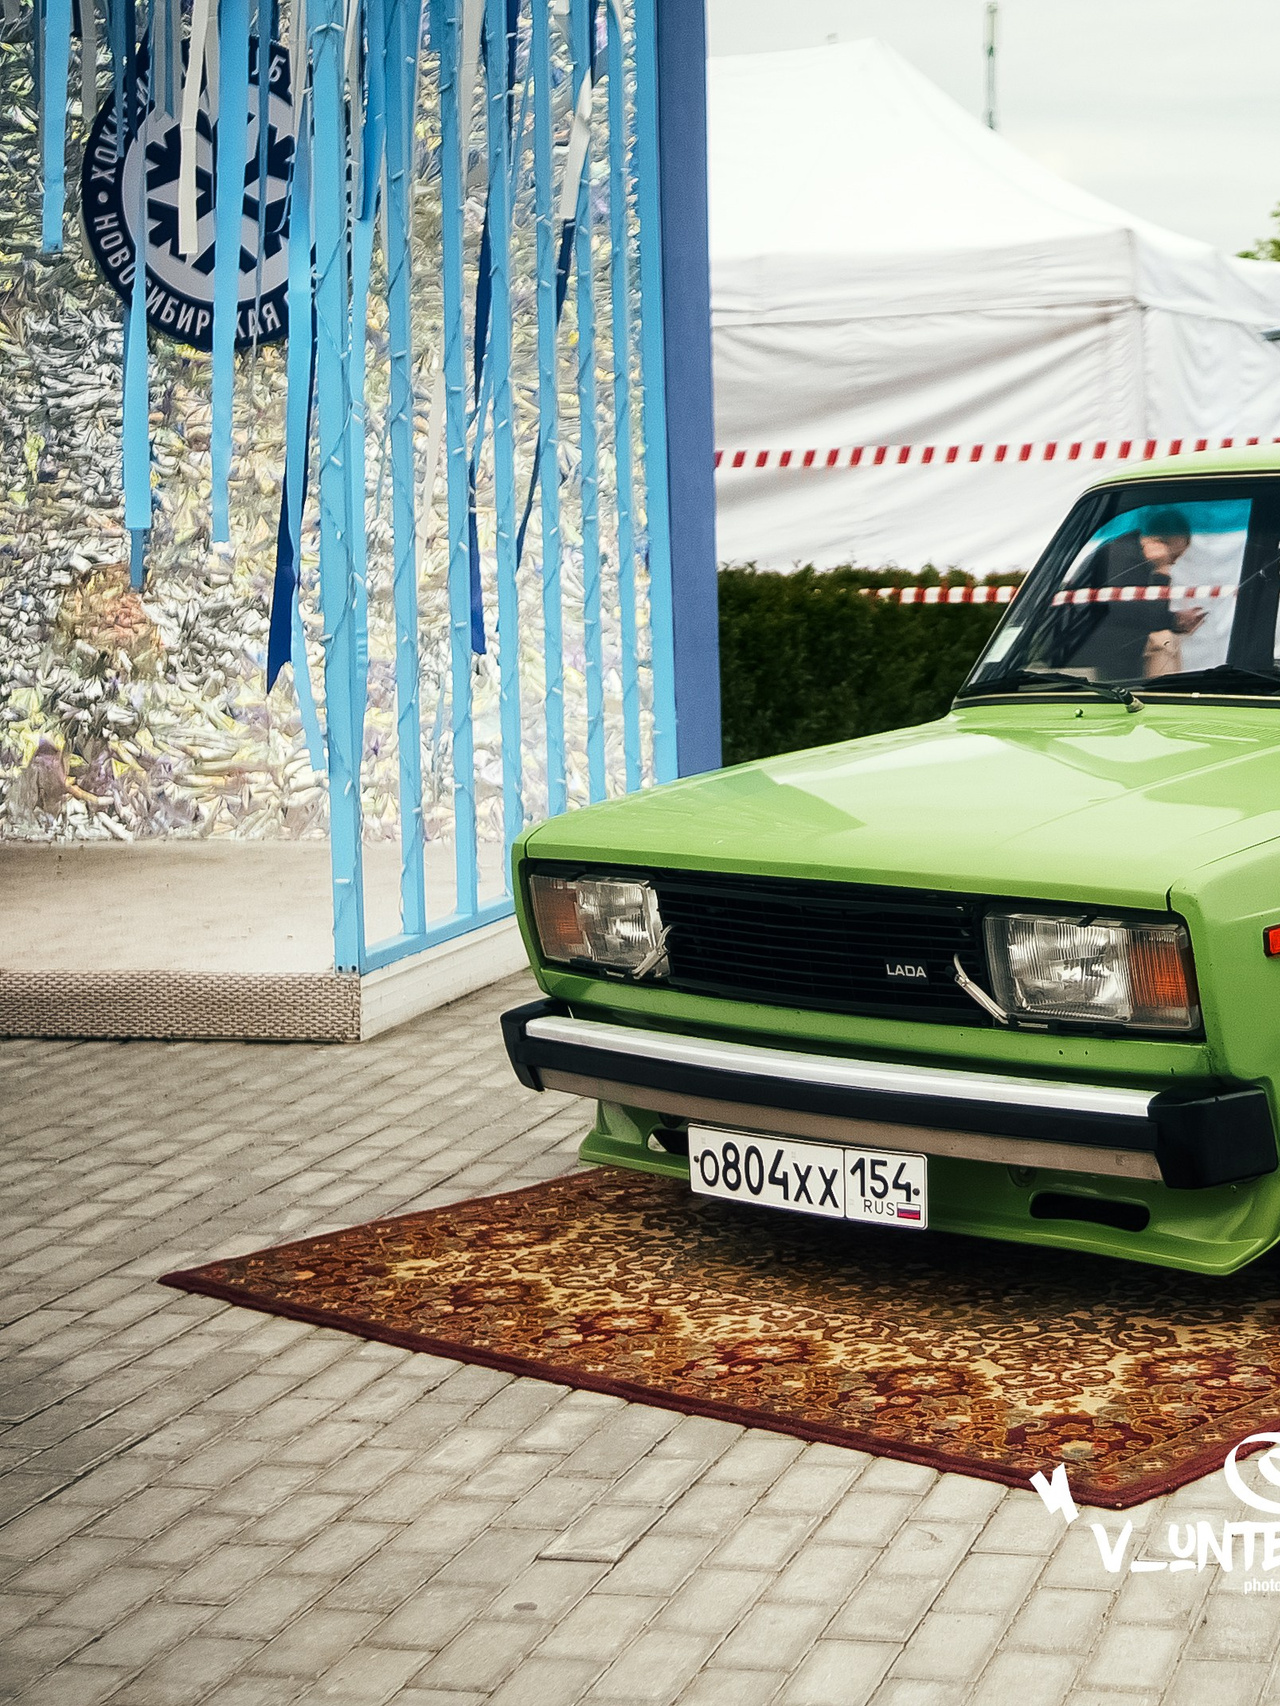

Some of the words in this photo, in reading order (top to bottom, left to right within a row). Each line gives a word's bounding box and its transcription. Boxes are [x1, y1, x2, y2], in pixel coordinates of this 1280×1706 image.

[886, 963, 927, 979] LADA
[850, 1157, 912, 1202] 154
[863, 1199, 895, 1217] RUS
